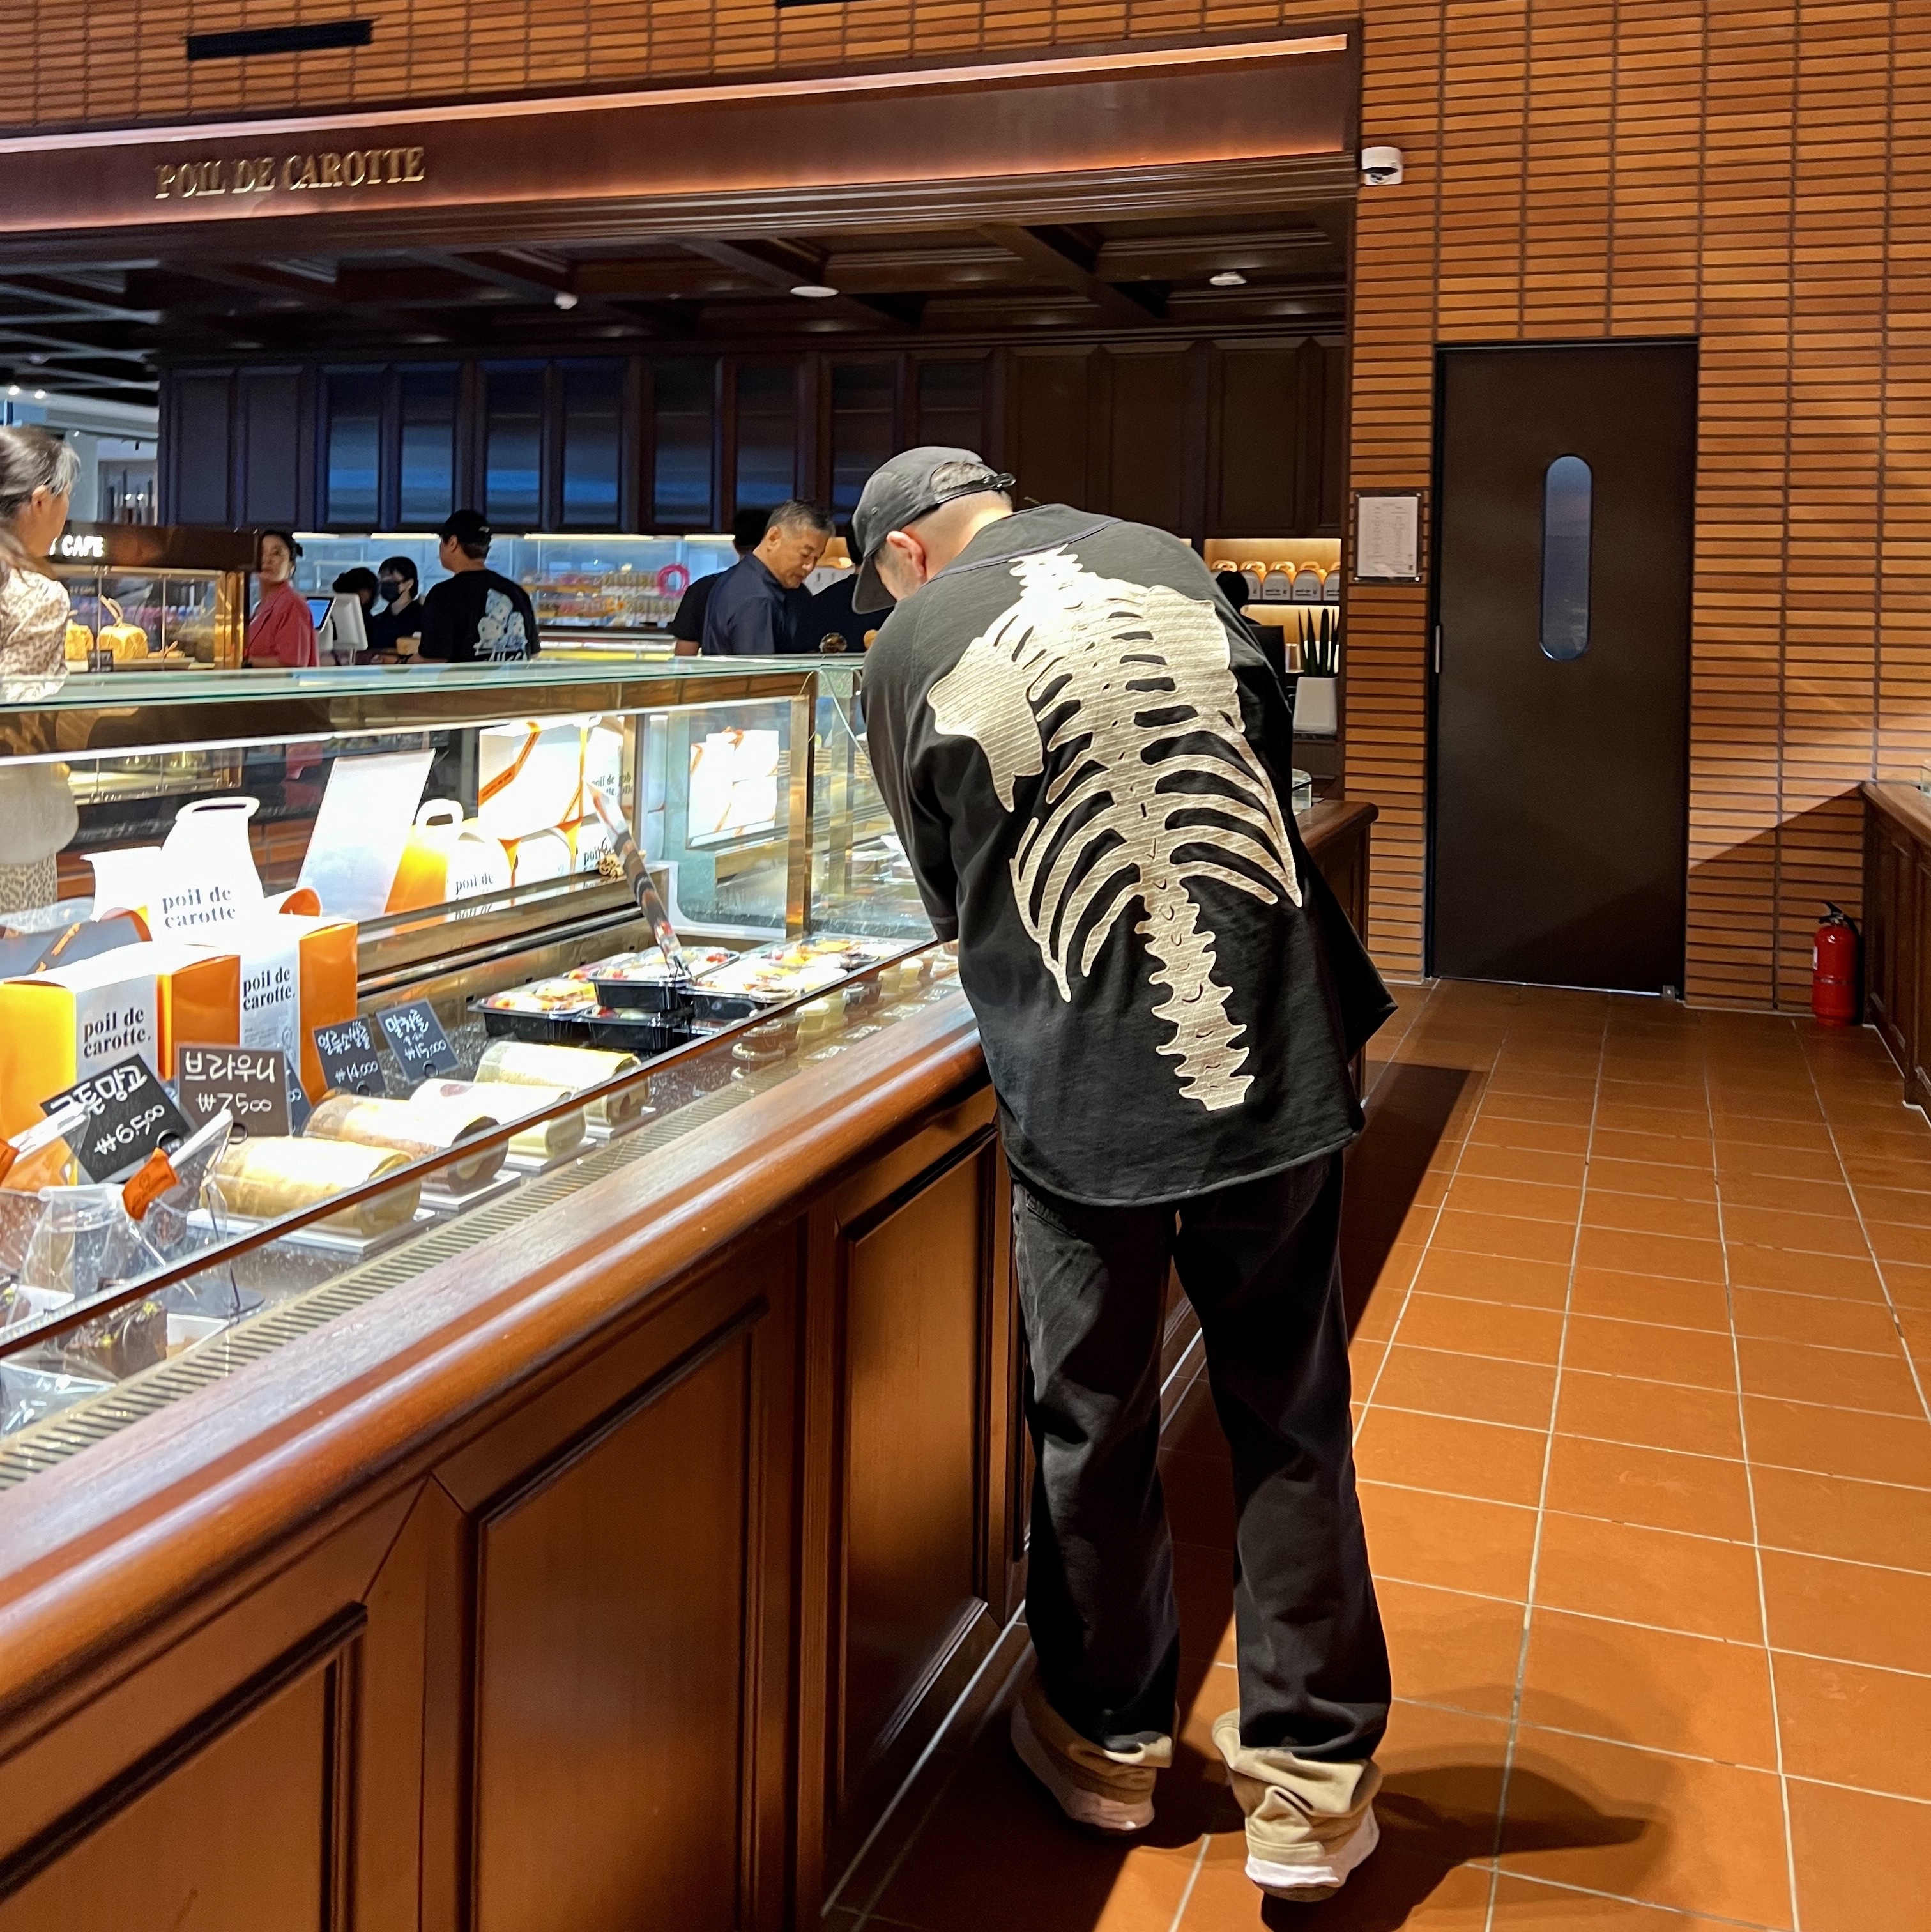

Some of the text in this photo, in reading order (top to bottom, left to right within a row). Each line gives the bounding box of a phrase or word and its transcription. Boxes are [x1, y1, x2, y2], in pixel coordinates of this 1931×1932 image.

[154, 146, 425, 199] POIL DE CAROTTE
[62, 535, 104, 557] CAFE
[456, 872, 494, 895] poil de
[163, 886, 231, 914] poil de
[165, 907, 236, 928] carotte
[243, 966, 290, 997] poil de
[243, 985, 295, 1011] carotte.
[84, 1007, 144, 1043] poil de
[84, 1027, 151, 1058] carotte.
[185, 1051, 275, 1083] 브라우니
